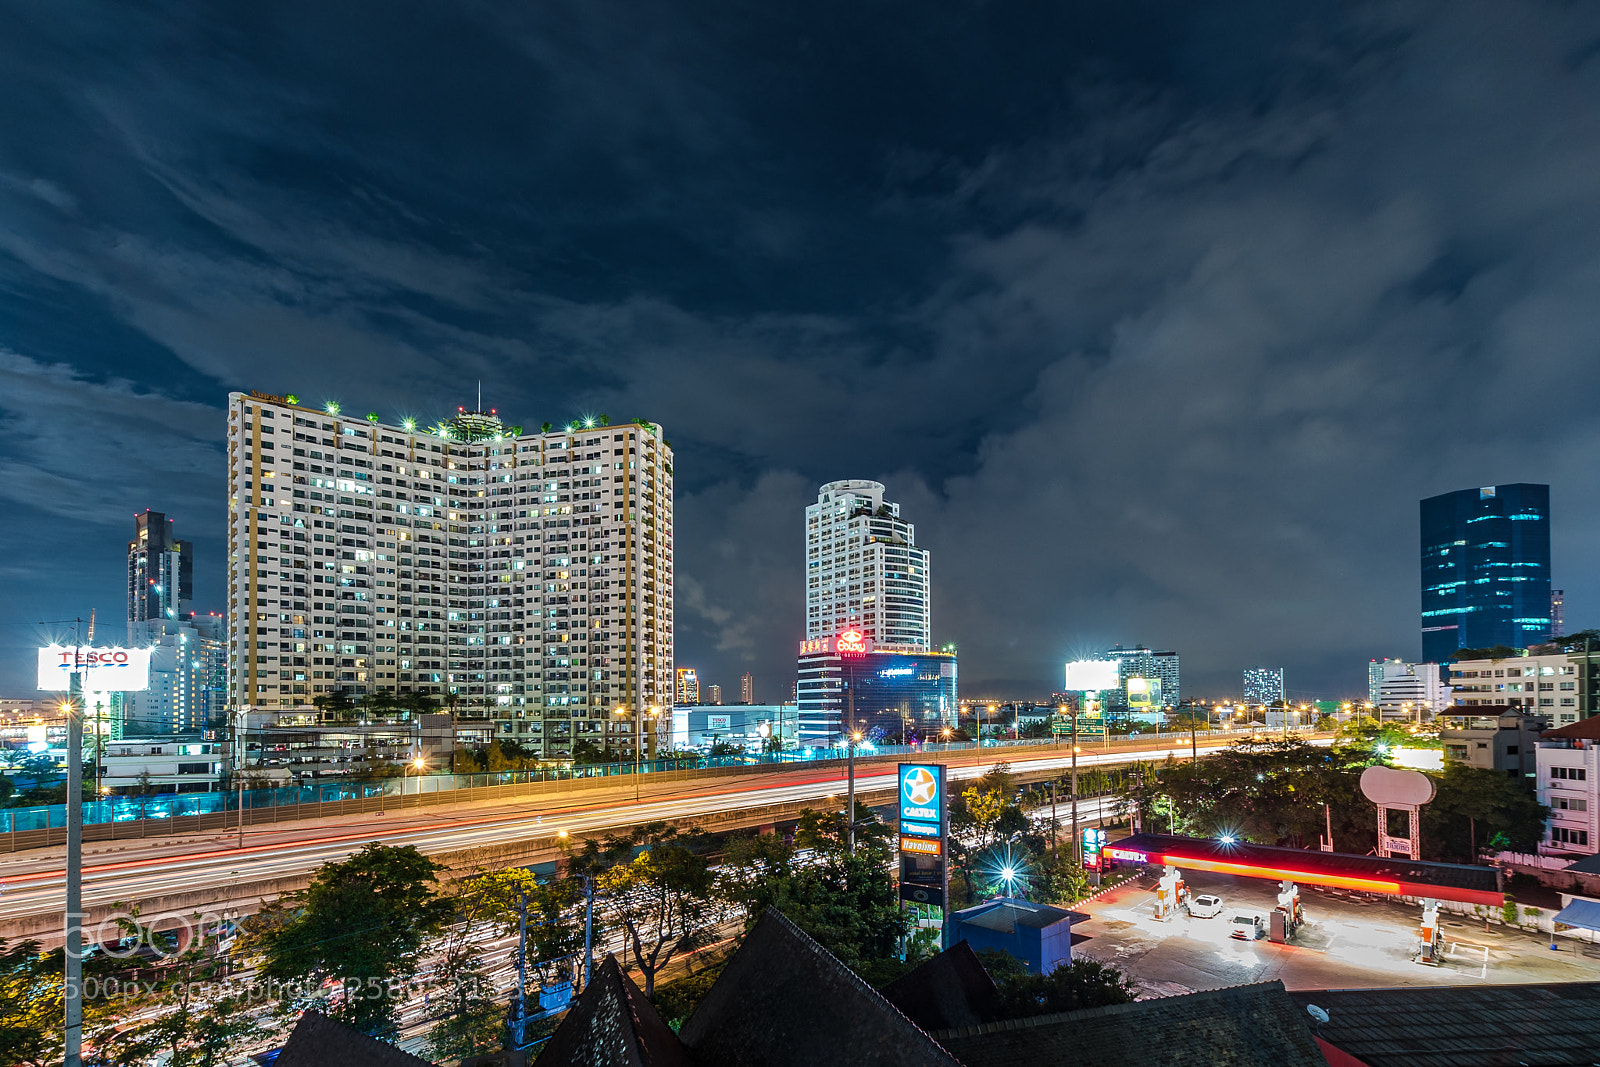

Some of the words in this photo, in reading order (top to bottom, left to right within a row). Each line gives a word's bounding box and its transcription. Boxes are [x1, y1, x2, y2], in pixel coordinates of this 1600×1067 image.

[57, 651, 129, 664] TESCO
[903, 806, 937, 819] CALTEX
[1112, 849, 1148, 863] CALTEX
